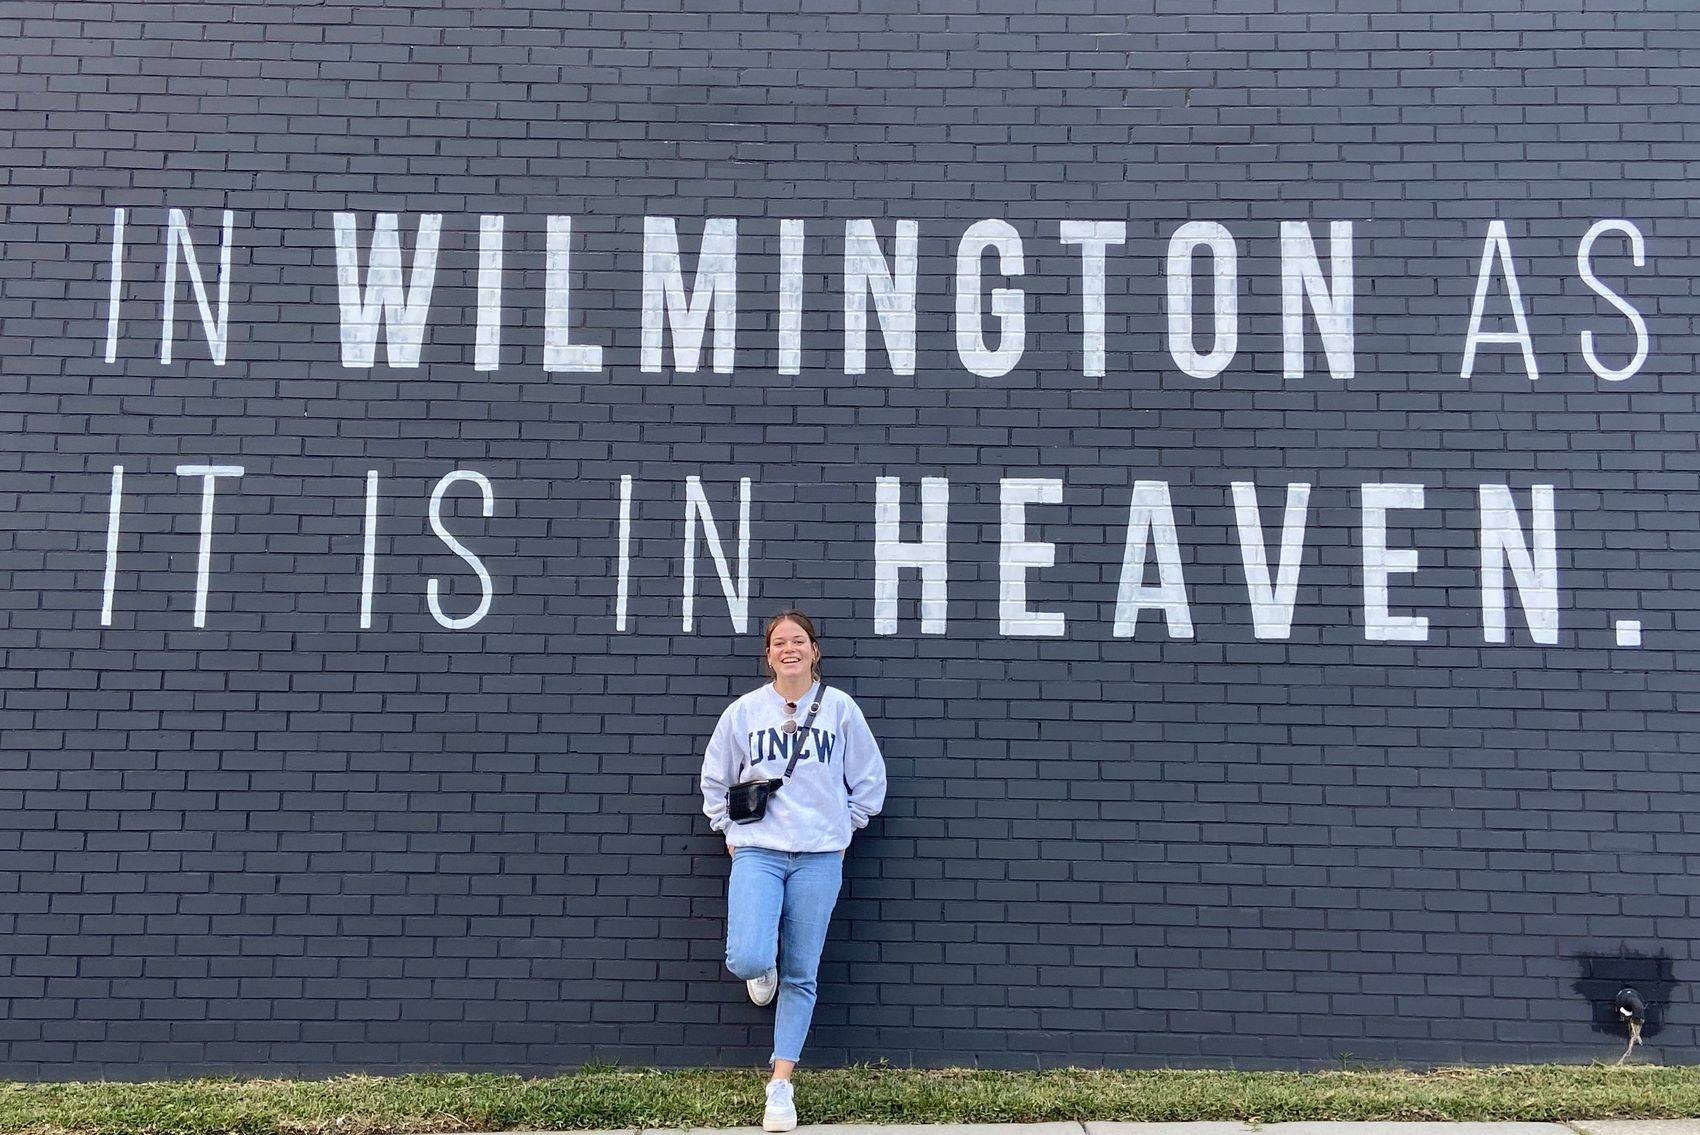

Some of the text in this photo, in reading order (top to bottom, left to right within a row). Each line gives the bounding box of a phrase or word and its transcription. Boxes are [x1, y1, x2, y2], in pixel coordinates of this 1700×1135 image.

[105, 208, 1650, 382] IN WILMINGTON AS
[100, 464, 1642, 647] IT IS IN HEAVEN.
